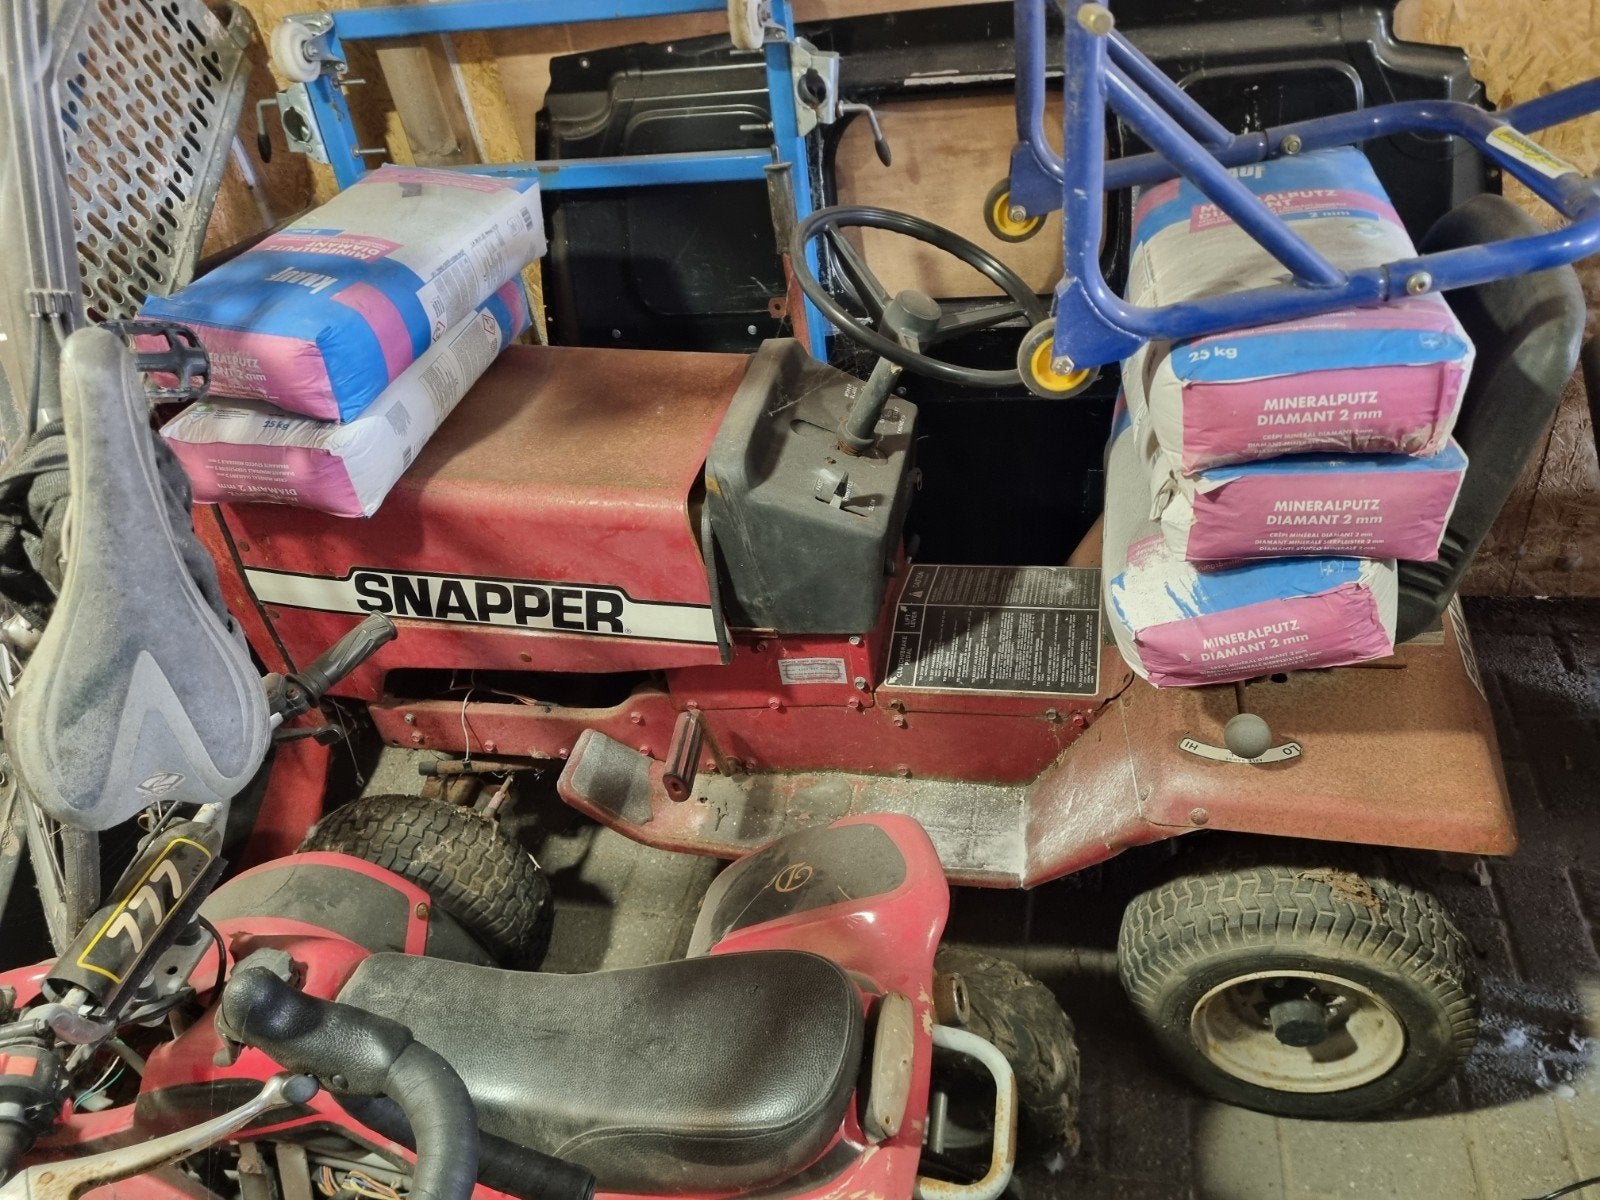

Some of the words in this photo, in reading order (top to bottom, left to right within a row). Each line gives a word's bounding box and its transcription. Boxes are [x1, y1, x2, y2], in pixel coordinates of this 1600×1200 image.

[265, 245, 371, 260] MINERALPUTZ
[306, 241, 380, 256] DIAMANT
[1188, 350, 1210, 363] 25
[1214, 346, 1238, 359] kg
[1264, 391, 1378, 411] MINERALPUTZ
[1258, 410, 1334, 426] DIAMANT
[1339, 410, 1350, 422] 2
[1353, 409, 1382, 420] mm
[276, 422, 290, 430] kg
[248, 486, 298, 496] DIAMANT
[1274, 499, 1380, 512] MINERALPUTZ
[1266, 514, 1339, 526] DIAMANT
[1343, 514, 1352, 524] 2
[1356, 515, 1382, 524] mm
[356, 572, 624, 634] SNAPPER
[1203, 620, 1300, 650] MINERALPUTZ
[1200, 641, 1266, 662] DIAMANT
[1270, 636, 1280, 648] 2
[1283, 634, 1309, 645] mm
[1184, 741, 1198, 751] HI
[1282, 744, 1301, 755] LO
[106, 859, 182, 954] 777
